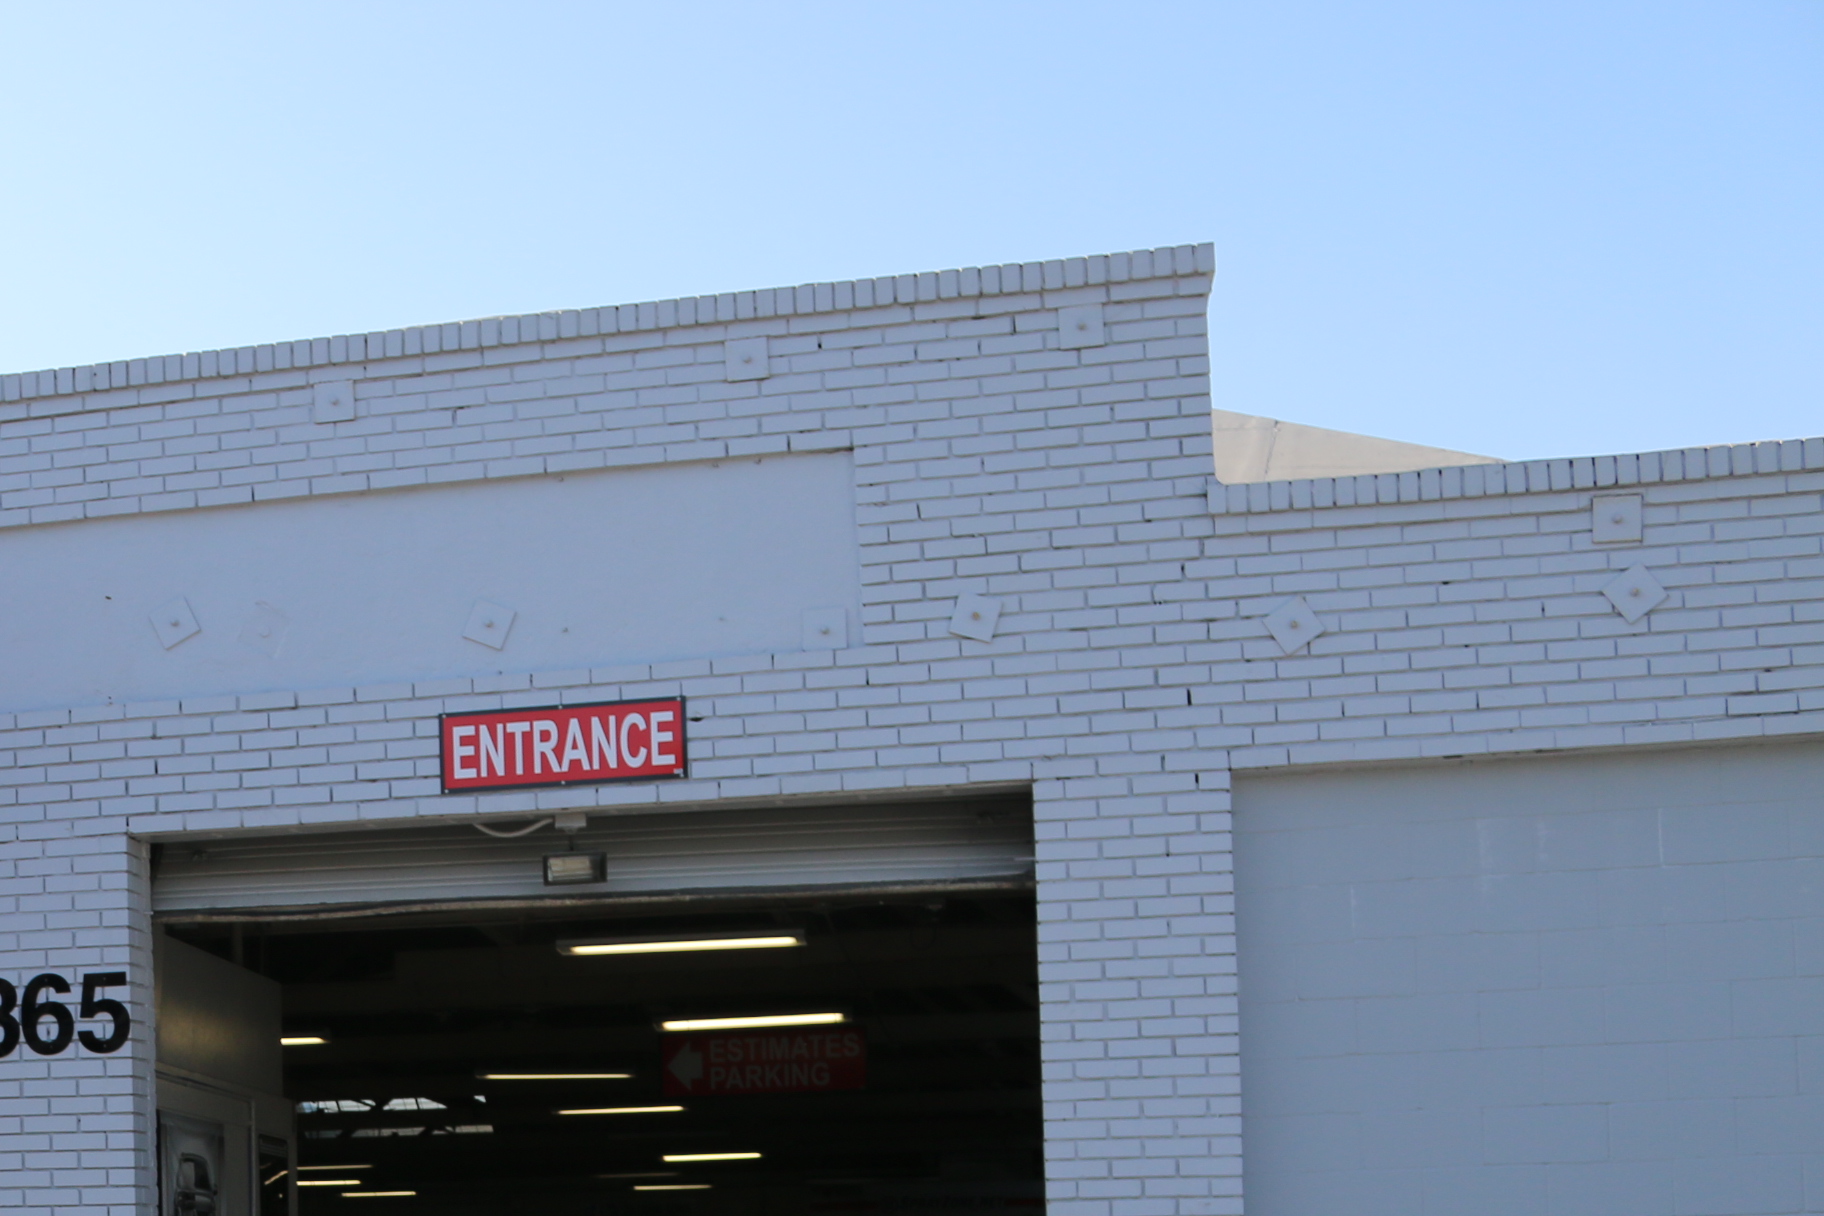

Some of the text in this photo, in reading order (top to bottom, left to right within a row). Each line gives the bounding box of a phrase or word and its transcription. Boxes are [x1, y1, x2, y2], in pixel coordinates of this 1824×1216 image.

[451, 710, 676, 780] ENTRANCE
[709, 1033, 860, 1063] ESTIMATES
[710, 1062, 830, 1090] PARKING
